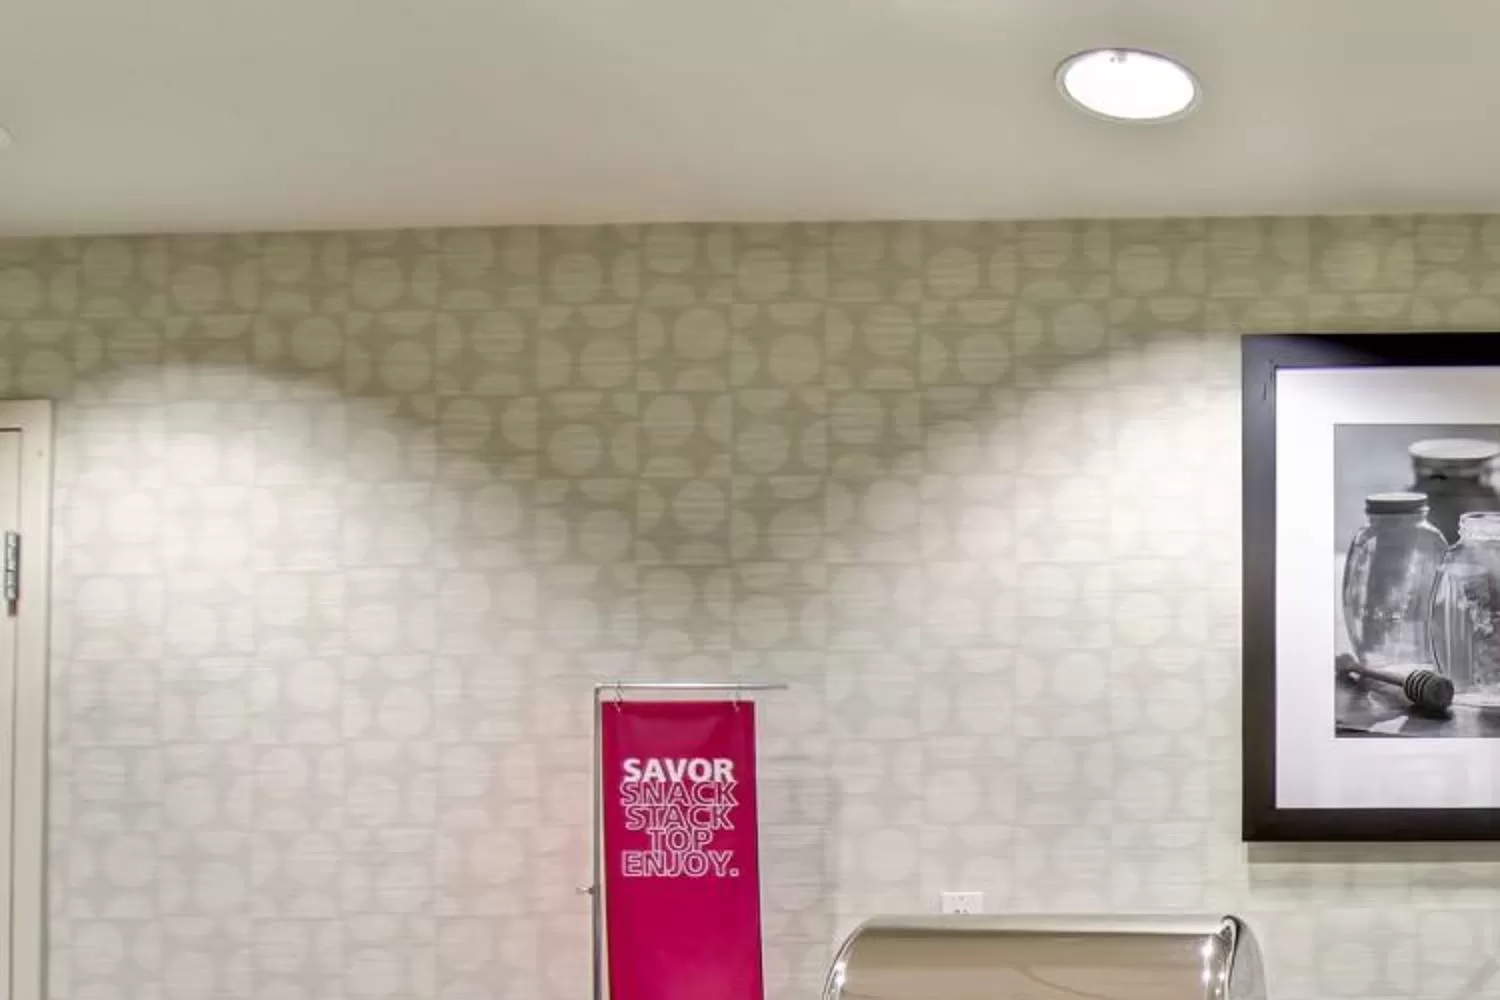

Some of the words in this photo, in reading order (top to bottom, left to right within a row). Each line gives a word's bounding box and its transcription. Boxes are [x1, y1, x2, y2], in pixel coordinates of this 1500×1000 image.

[622, 757, 737, 783] SAVOR
[620, 781, 739, 806] SNACK
[625, 805, 736, 830] STACK
[647, 828, 713, 853] TOP
[621, 850, 740, 877] ENJOY.
